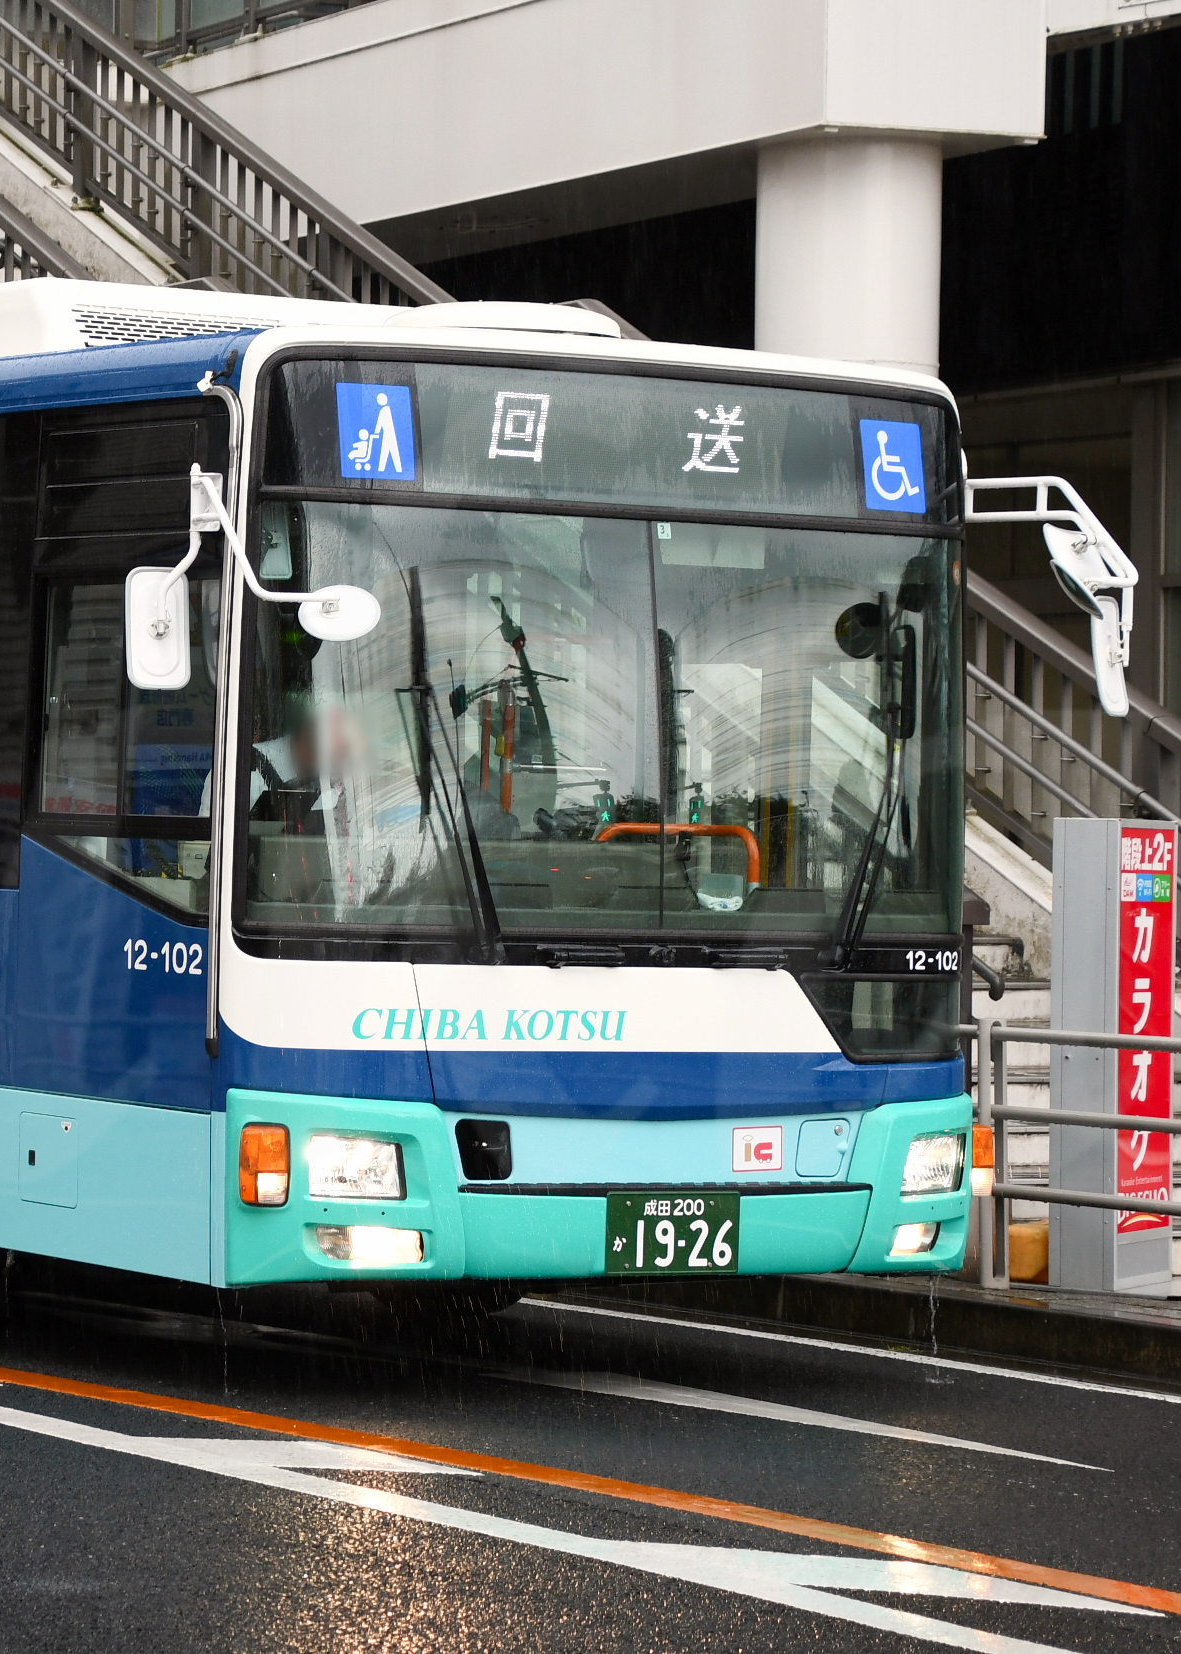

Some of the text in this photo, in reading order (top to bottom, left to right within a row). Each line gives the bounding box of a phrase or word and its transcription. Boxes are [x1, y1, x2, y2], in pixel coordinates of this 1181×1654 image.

[1121, 832, 1173, 871] 階段上2F
[123, 938, 203, 975] 12-102
[905, 950, 959, 971] 12-102
[351, 1007, 628, 1041] CHIBA KOTSU
[643, 1198, 705, 1216] 成田 200
[612, 1219, 733, 1268] か 19-26
